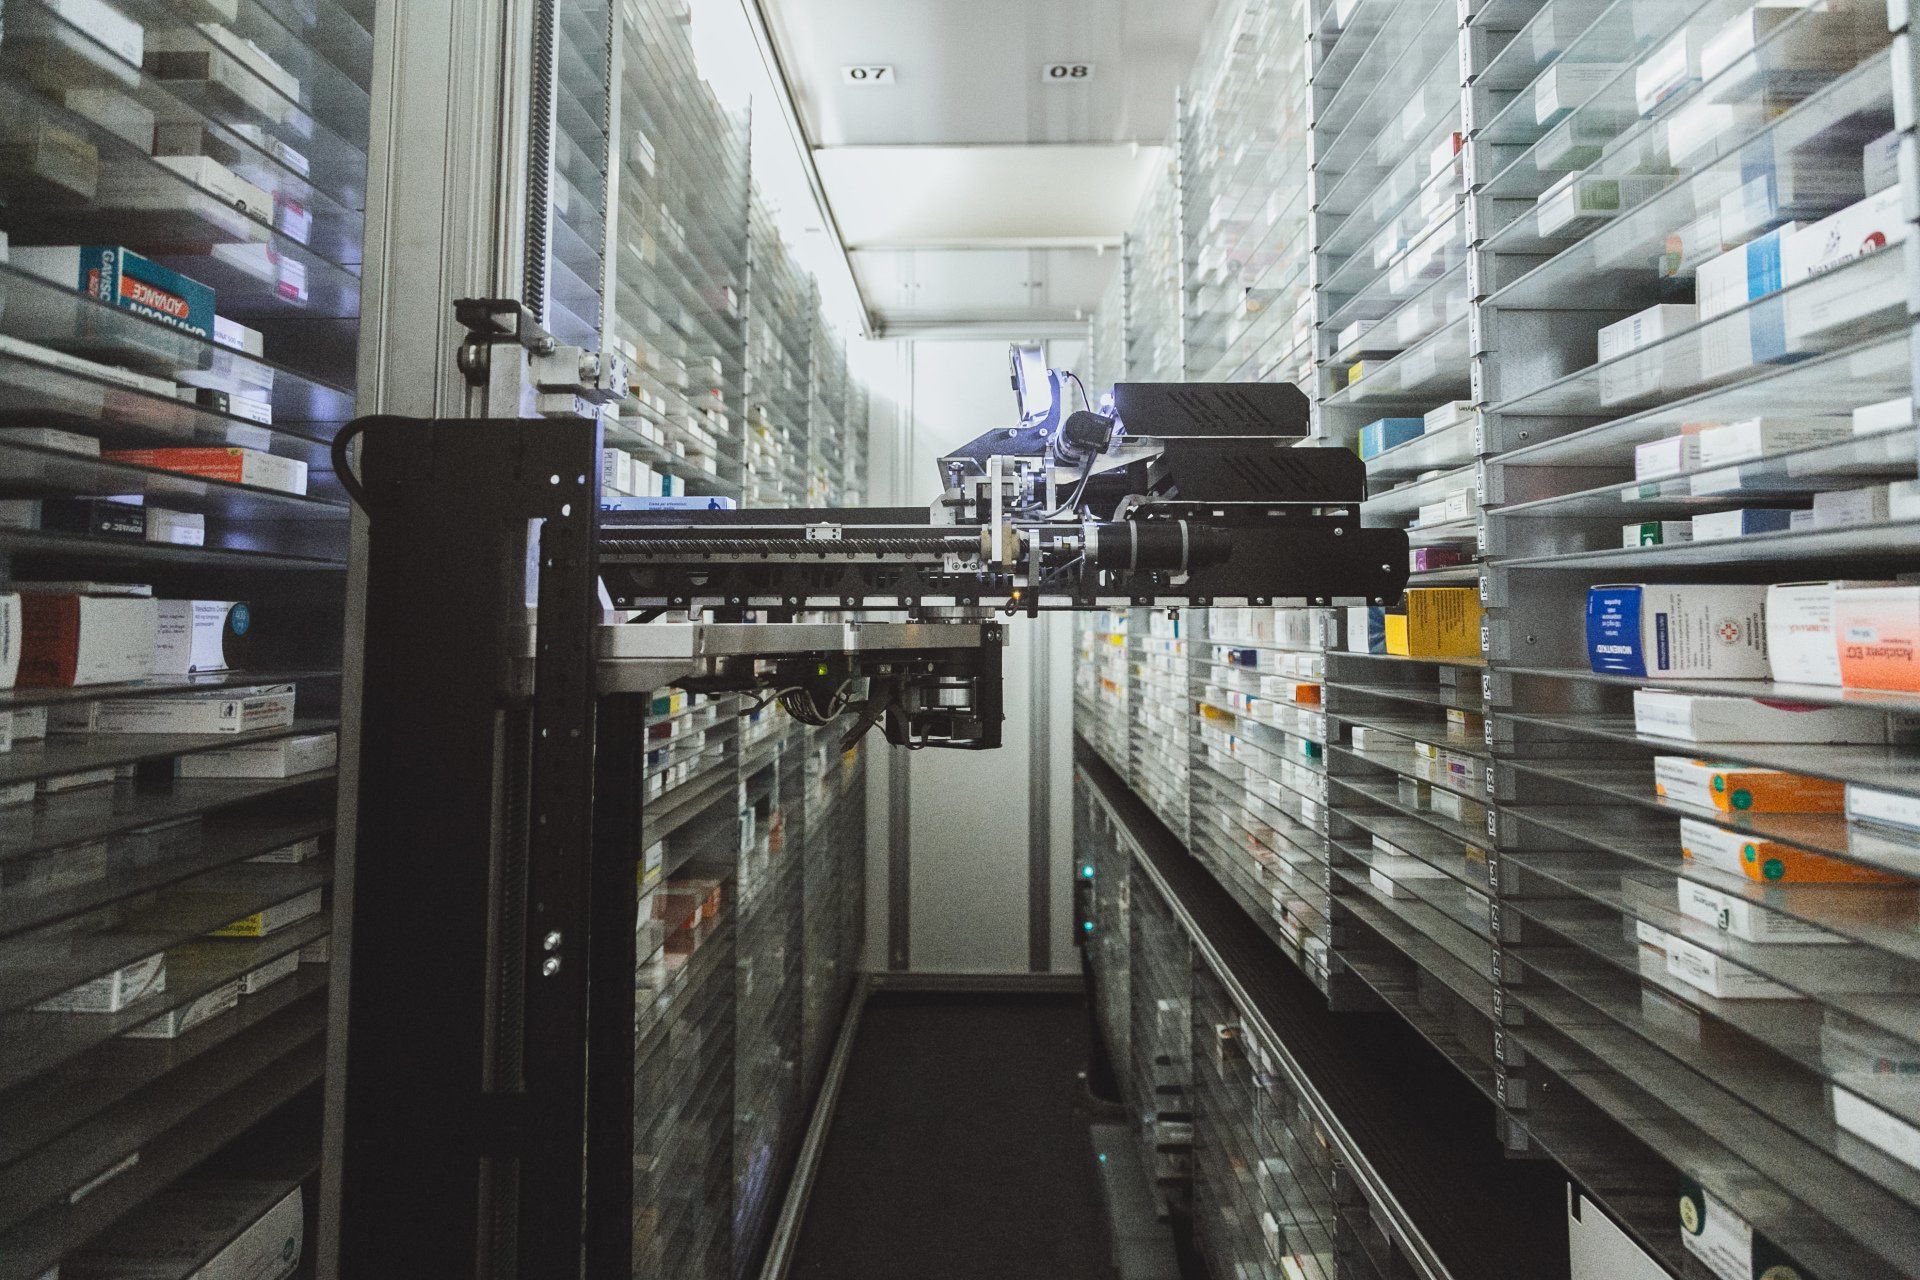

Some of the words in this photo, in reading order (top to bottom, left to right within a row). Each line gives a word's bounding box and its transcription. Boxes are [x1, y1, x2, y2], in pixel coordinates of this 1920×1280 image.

[850, 67, 886, 80] 07
[1049, 65, 1088, 79] 08
[99, 249, 115, 302] GAVISC
[132, 283, 182, 316] ADVANCE
